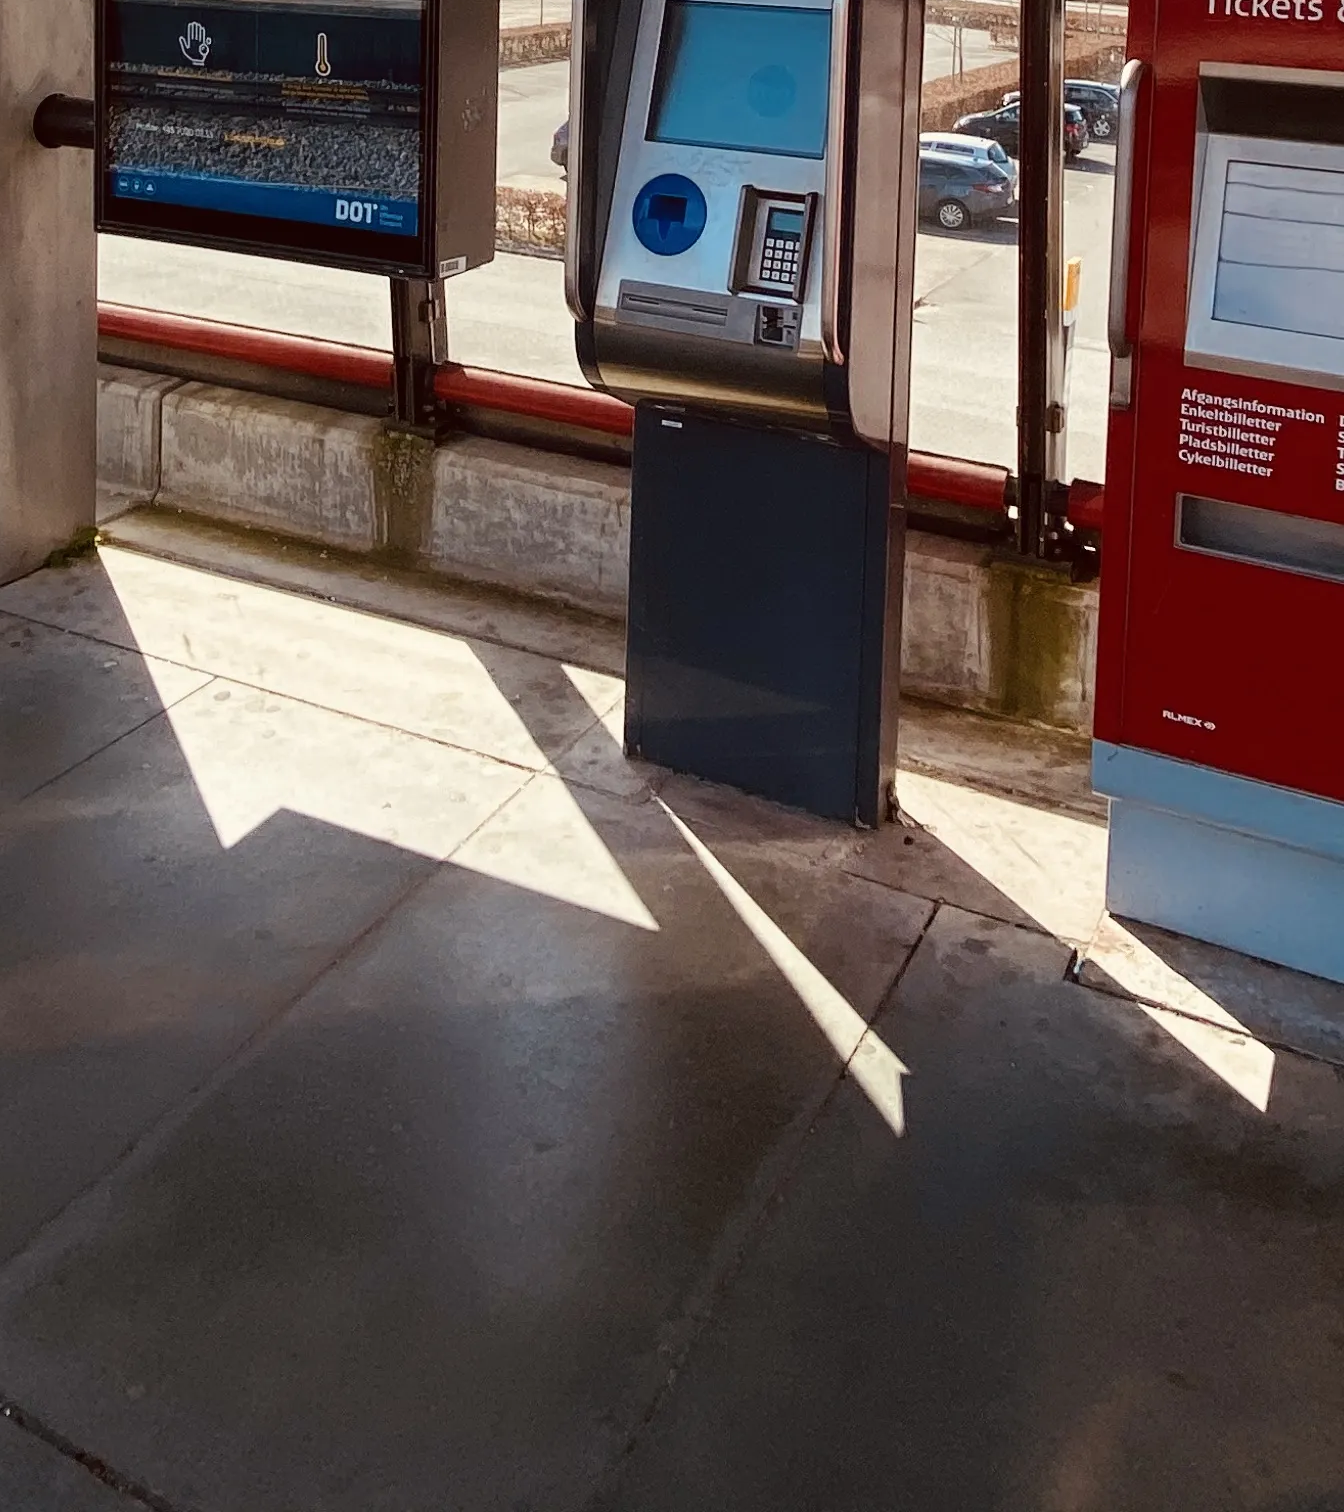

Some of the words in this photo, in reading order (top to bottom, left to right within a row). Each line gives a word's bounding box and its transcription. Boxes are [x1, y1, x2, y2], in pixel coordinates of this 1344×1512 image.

[335, 199, 378, 224] DOT
[1180, 402, 1282, 432] Enkeltbilletter
[1181, 387, 1326, 424] Afgangsinformation
[1179, 418, 1276, 447] Turistbilletter
[1178, 448, 1274, 478] Cykelbilletter
[1179, 433, 1275, 463] Pladsbilletter
